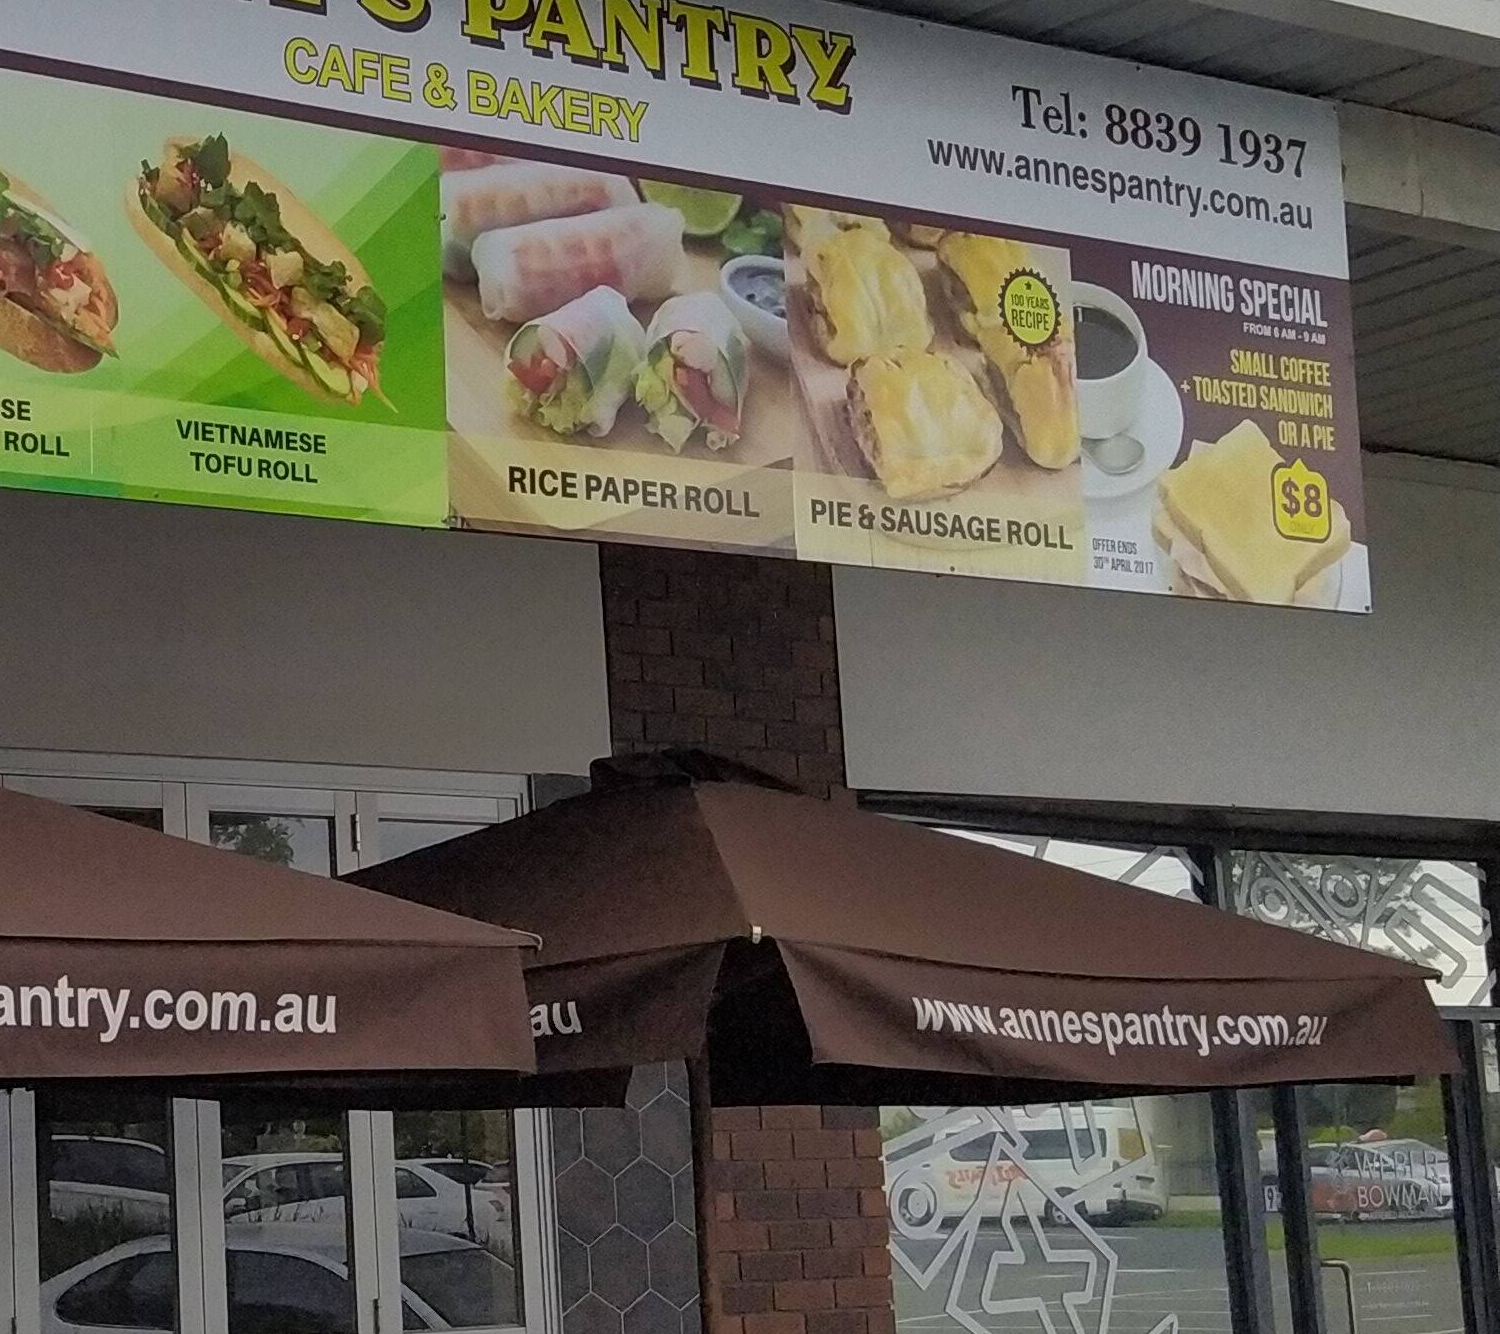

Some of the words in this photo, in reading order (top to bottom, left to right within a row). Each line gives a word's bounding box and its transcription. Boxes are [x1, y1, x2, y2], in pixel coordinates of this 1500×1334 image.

[284, 37, 412, 104] CAFE
[423, 61, 459, 110] &
[467, 71, 649, 143] BAKERY
[1011, 85, 1088, 139] Tel:
[1105, 103, 1202, 158] 8839
[1217, 123, 1306, 178] 1937
[927, 137, 1313, 230] www.annespantry.com.au
[1010, 294, 1024, 308] 100
[1026, 295, 1050, 310] YEARS
[1130, 260, 1235, 313] MORNING
[1240, 278, 1328, 328] SPECIAL
[1011, 308, 1050, 331] RECIPE
[1243, 322, 1271, 337] FROM
[1281, 328, 1296, 340] AM
[1310, 333, 1326, 345] AM
[1229, 349, 1276, 380] SMALL
[1280, 355, 1331, 387] COFFEE
[1193, 375, 1257, 409] TOASTED
[1260, 385, 1334, 419] SANDWICH
[3, 430, 70, 458] ROLL
[175, 418, 327, 455] VIETNAMESE
[1278, 419, 1299, 446] OR
[1300, 424, 1311, 448] A
[1312, 425, 1336, 452] PIE
[189, 450, 253, 478] TOFU
[256, 457, 319, 484] ROLL
[507, 465, 578, 500] RICE
[583, 474, 679, 510] PAPER
[683, 485, 761, 518] ROLL
[1281, 477, 1323, 518] $8
[809, 498, 852, 529] PIE
[857, 504, 877, 531] &
[880, 506, 1001, 543] SAUSAGE
[1006, 519, 1074, 551] ROLL
[1092, 537, 1116, 553] OFFER
[1117, 540, 1138, 555] ENDS
[1111, 557, 1133, 572] APRIL
[912, 993, 1328, 1058] www.annespantry.com.au
[1355, 1151, 1448, 1181] WEBER
[1357, 1183, 1444, 1209] BOWMAN
